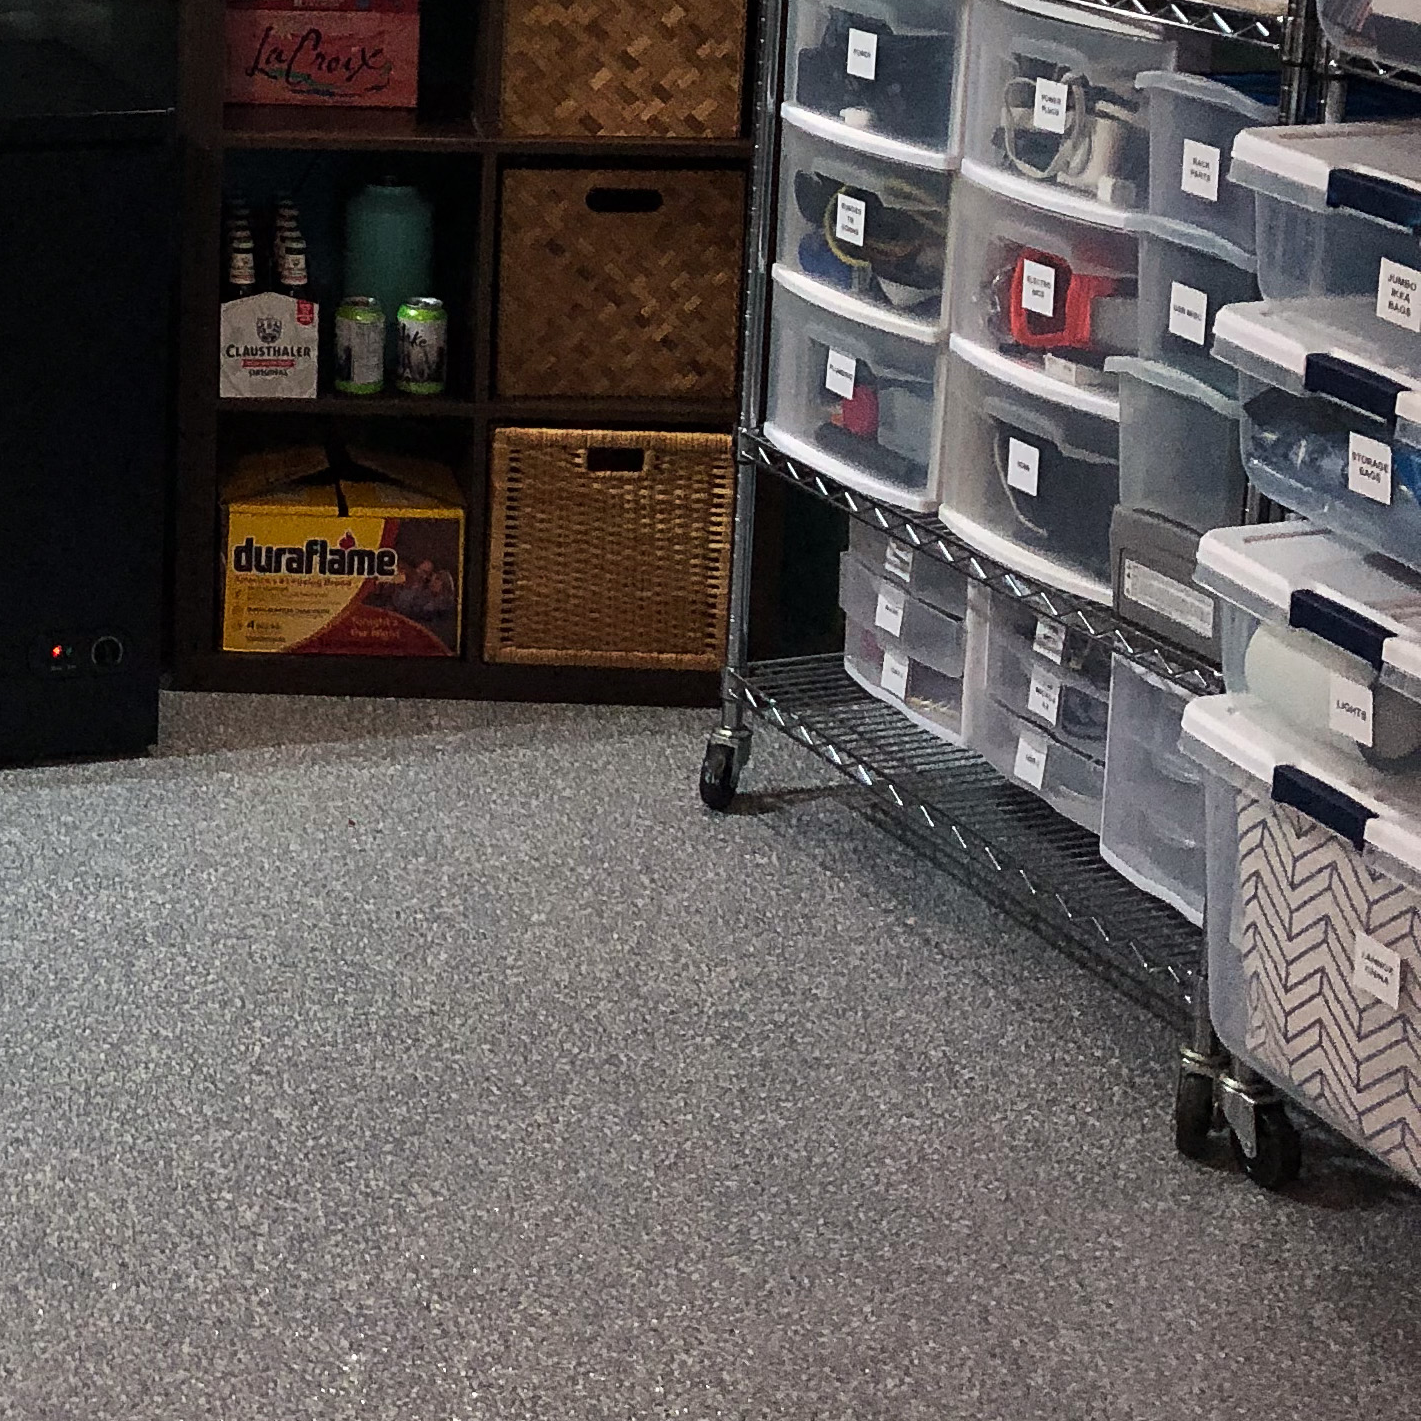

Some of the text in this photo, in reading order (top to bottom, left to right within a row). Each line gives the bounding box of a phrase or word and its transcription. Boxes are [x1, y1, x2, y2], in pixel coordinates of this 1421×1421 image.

[1387, 273, 1417, 292] JUMBO
[1390, 287, 1411, 304] IKEA
[1387, 300, 1412, 318] BAGS
[225, 343, 312, 359] CLAUSTHALER
[1351, 451, 1389, 473] STORAGE
[1358, 466, 1382, 484] BAGS
[233, 537, 398, 577] duraflame
[1335, 699, 1367, 722] LIGHTS
